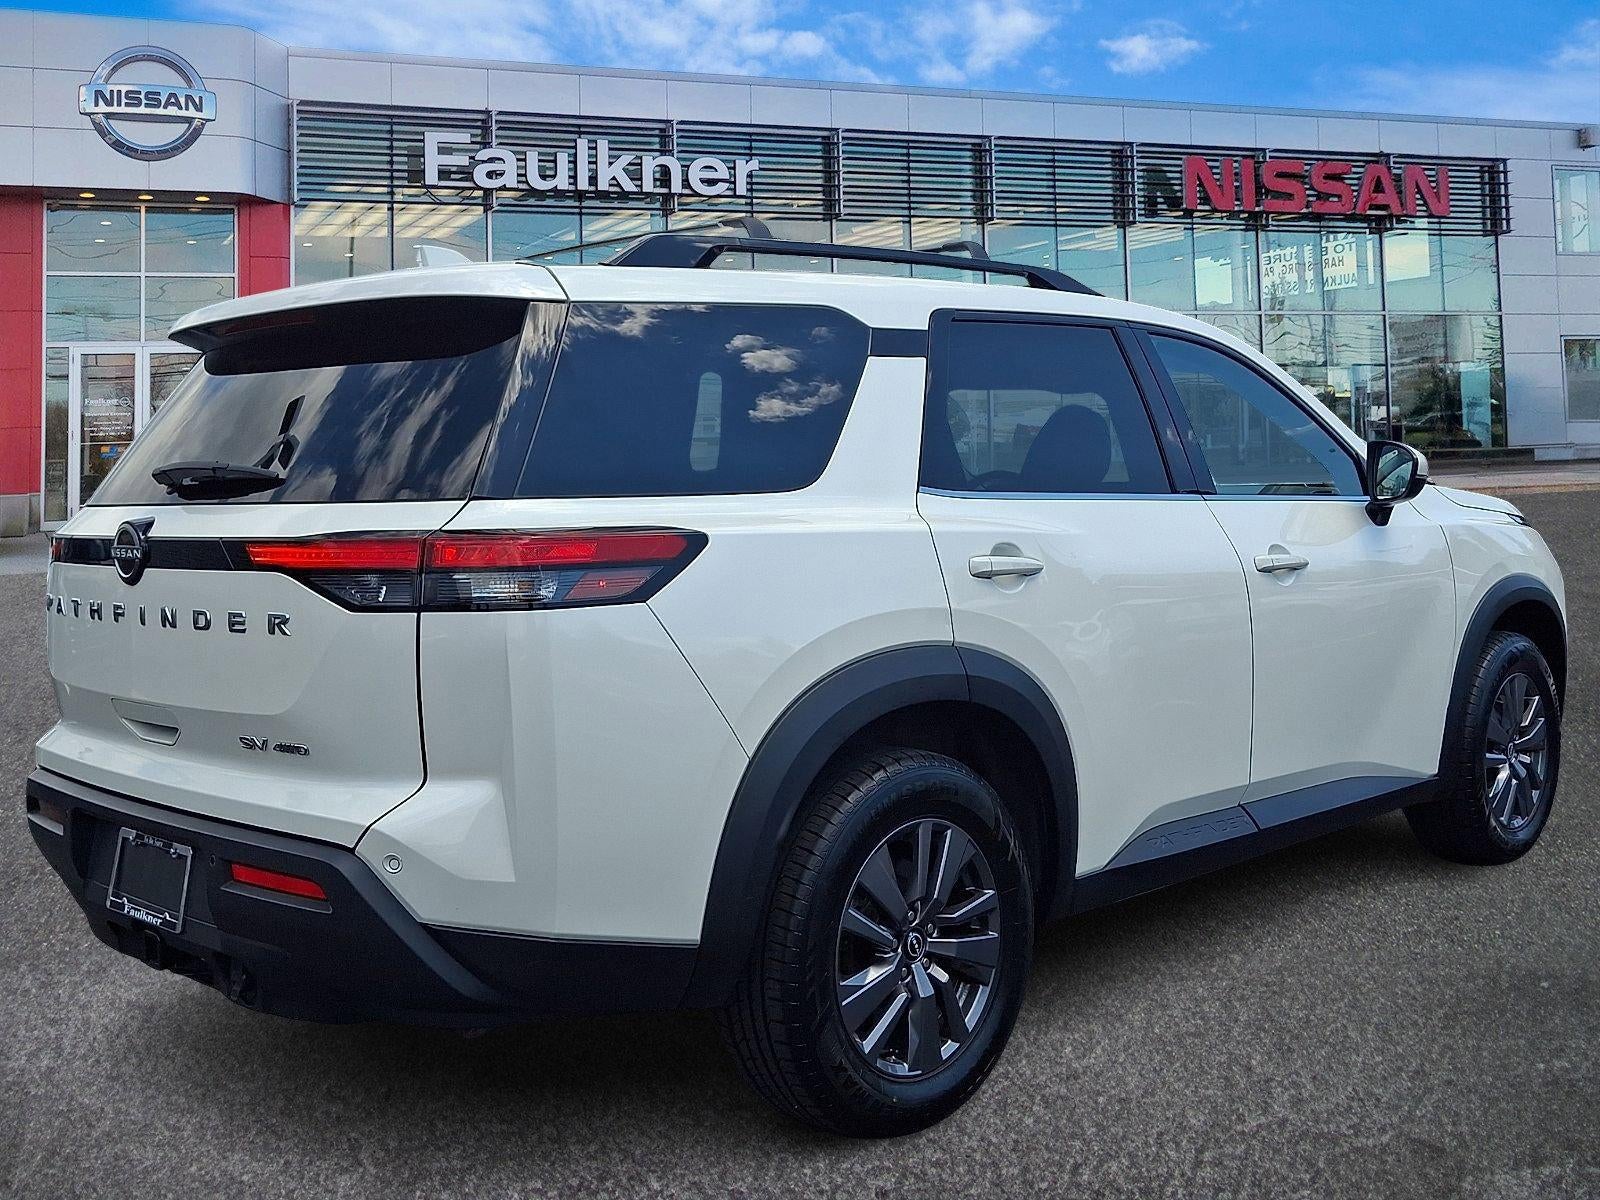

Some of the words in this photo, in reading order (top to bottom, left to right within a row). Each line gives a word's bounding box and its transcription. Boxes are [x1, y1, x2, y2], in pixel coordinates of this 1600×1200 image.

[93, 89, 204, 113] NISSAN
[423, 131, 760, 196] Faulkner
[1182, 155, 1451, 216] NISSAN
[110, 548, 141, 558] SSAN
[47, 593, 291, 636] PATHFINDER
[238, 734, 268, 752] SV
[123, 904, 163, 927] Faulkner
